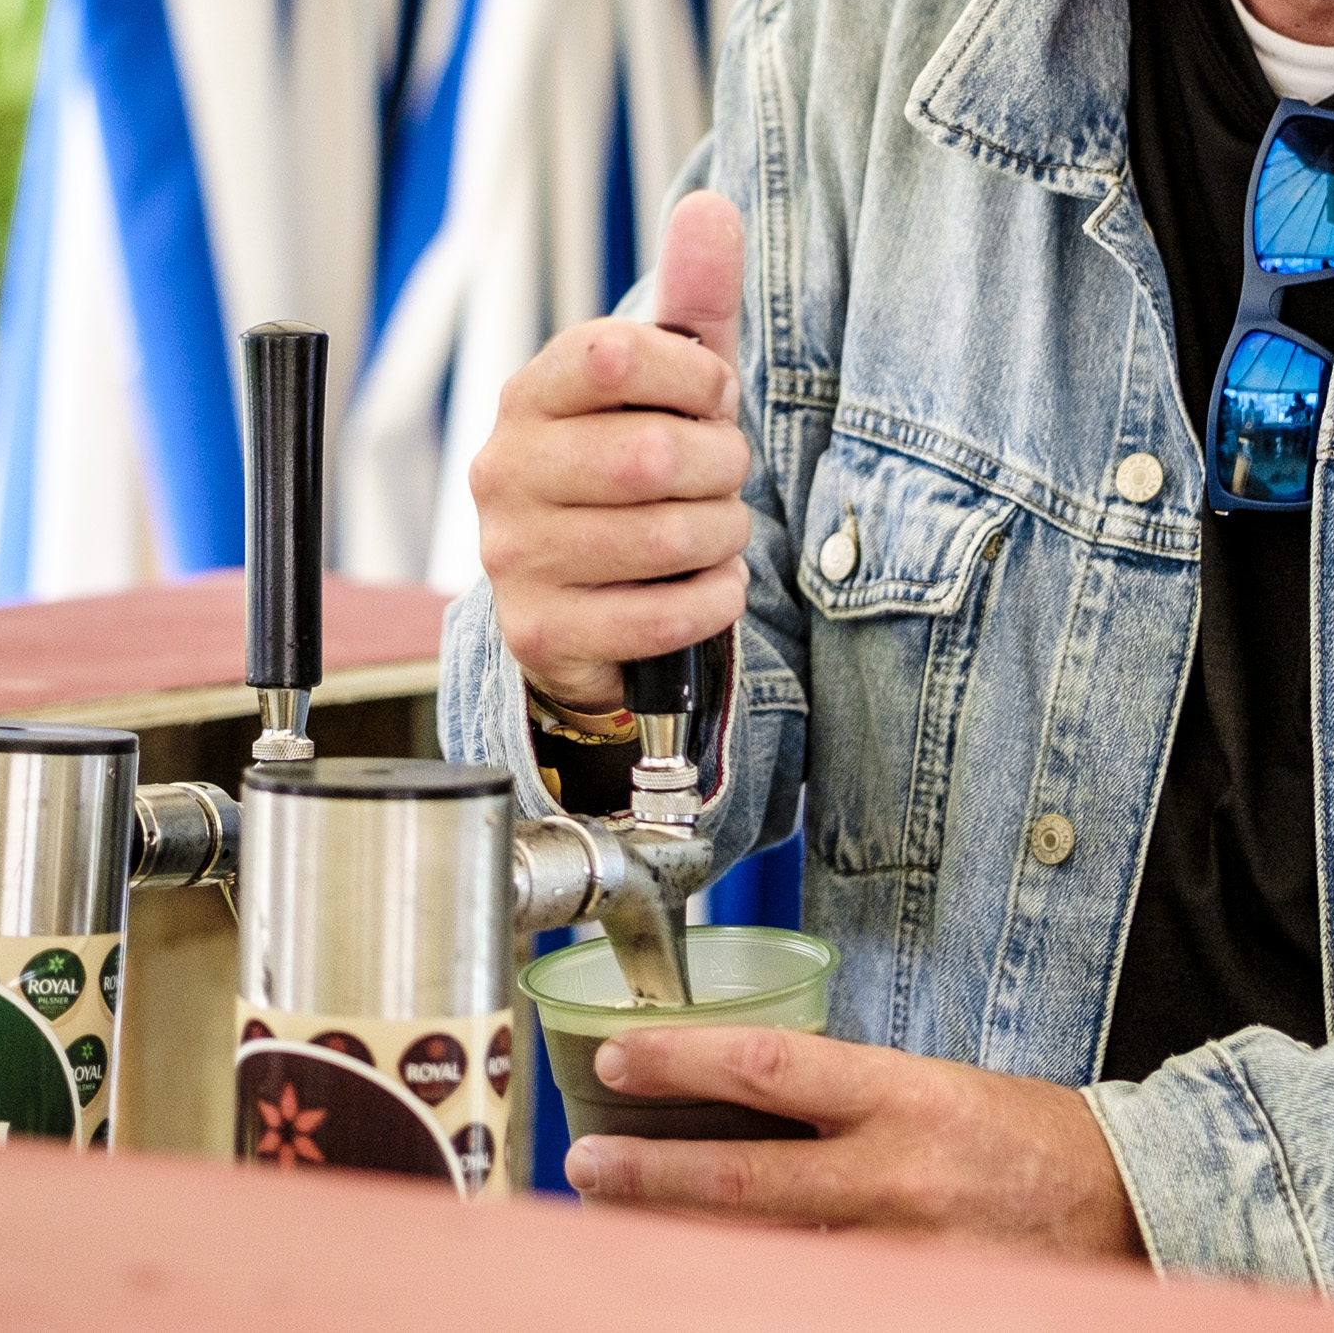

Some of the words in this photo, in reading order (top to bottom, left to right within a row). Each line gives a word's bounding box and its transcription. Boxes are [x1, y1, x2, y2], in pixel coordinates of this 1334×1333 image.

[28, 978, 79, 994] ROYAL
[73, 1064, 103, 1082] OYAL
[405, 1062, 461, 1084] ROYAL
[460, 1151, 491, 1172] OYAL
